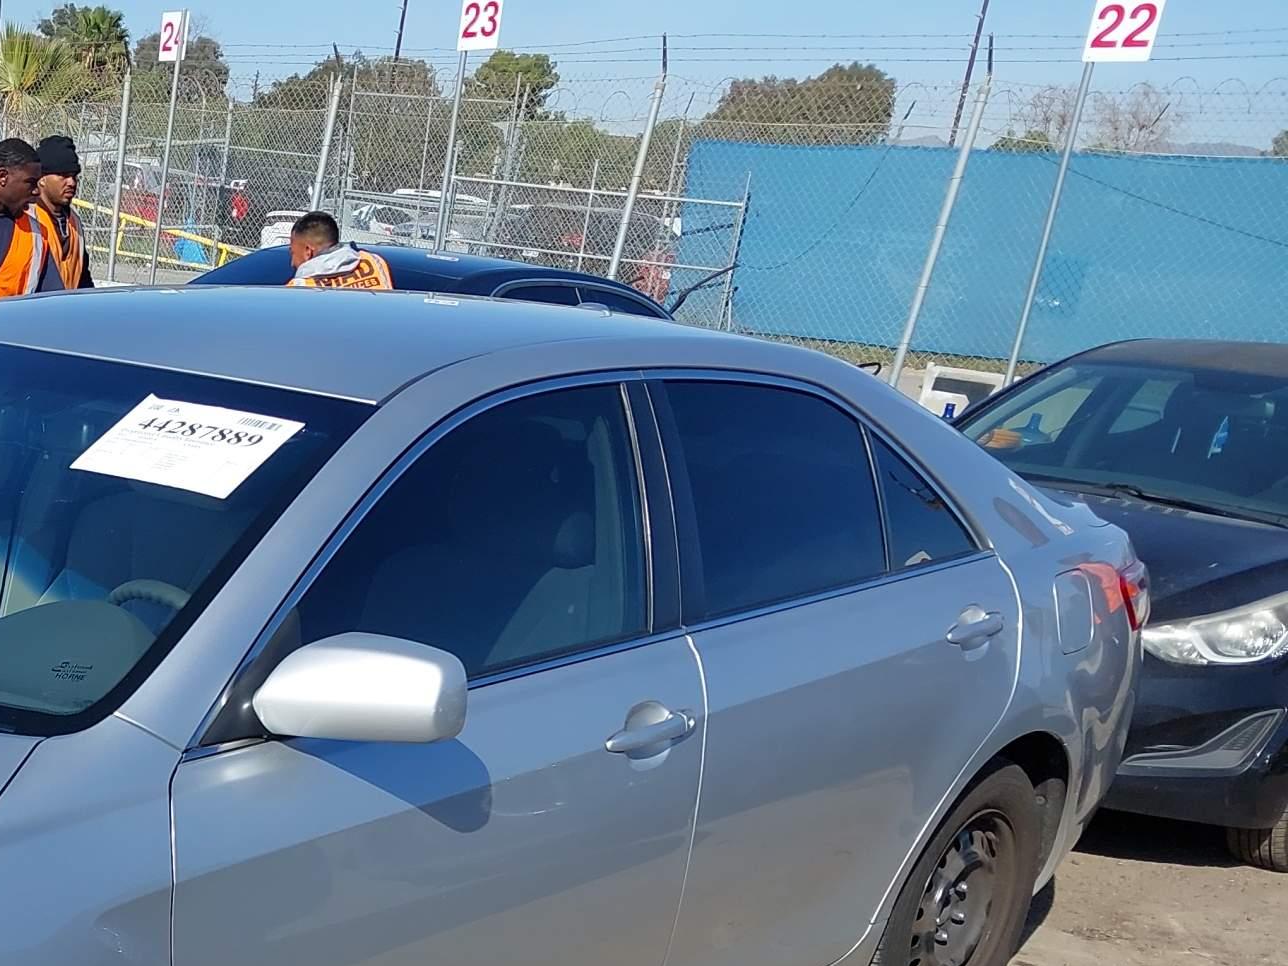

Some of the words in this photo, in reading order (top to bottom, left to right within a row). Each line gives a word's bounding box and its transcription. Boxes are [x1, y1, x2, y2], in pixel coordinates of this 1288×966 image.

[462, 1, 499, 38] 23
[1090, 3, 1158, 48] 22
[138, 417, 264, 447] 44287889
